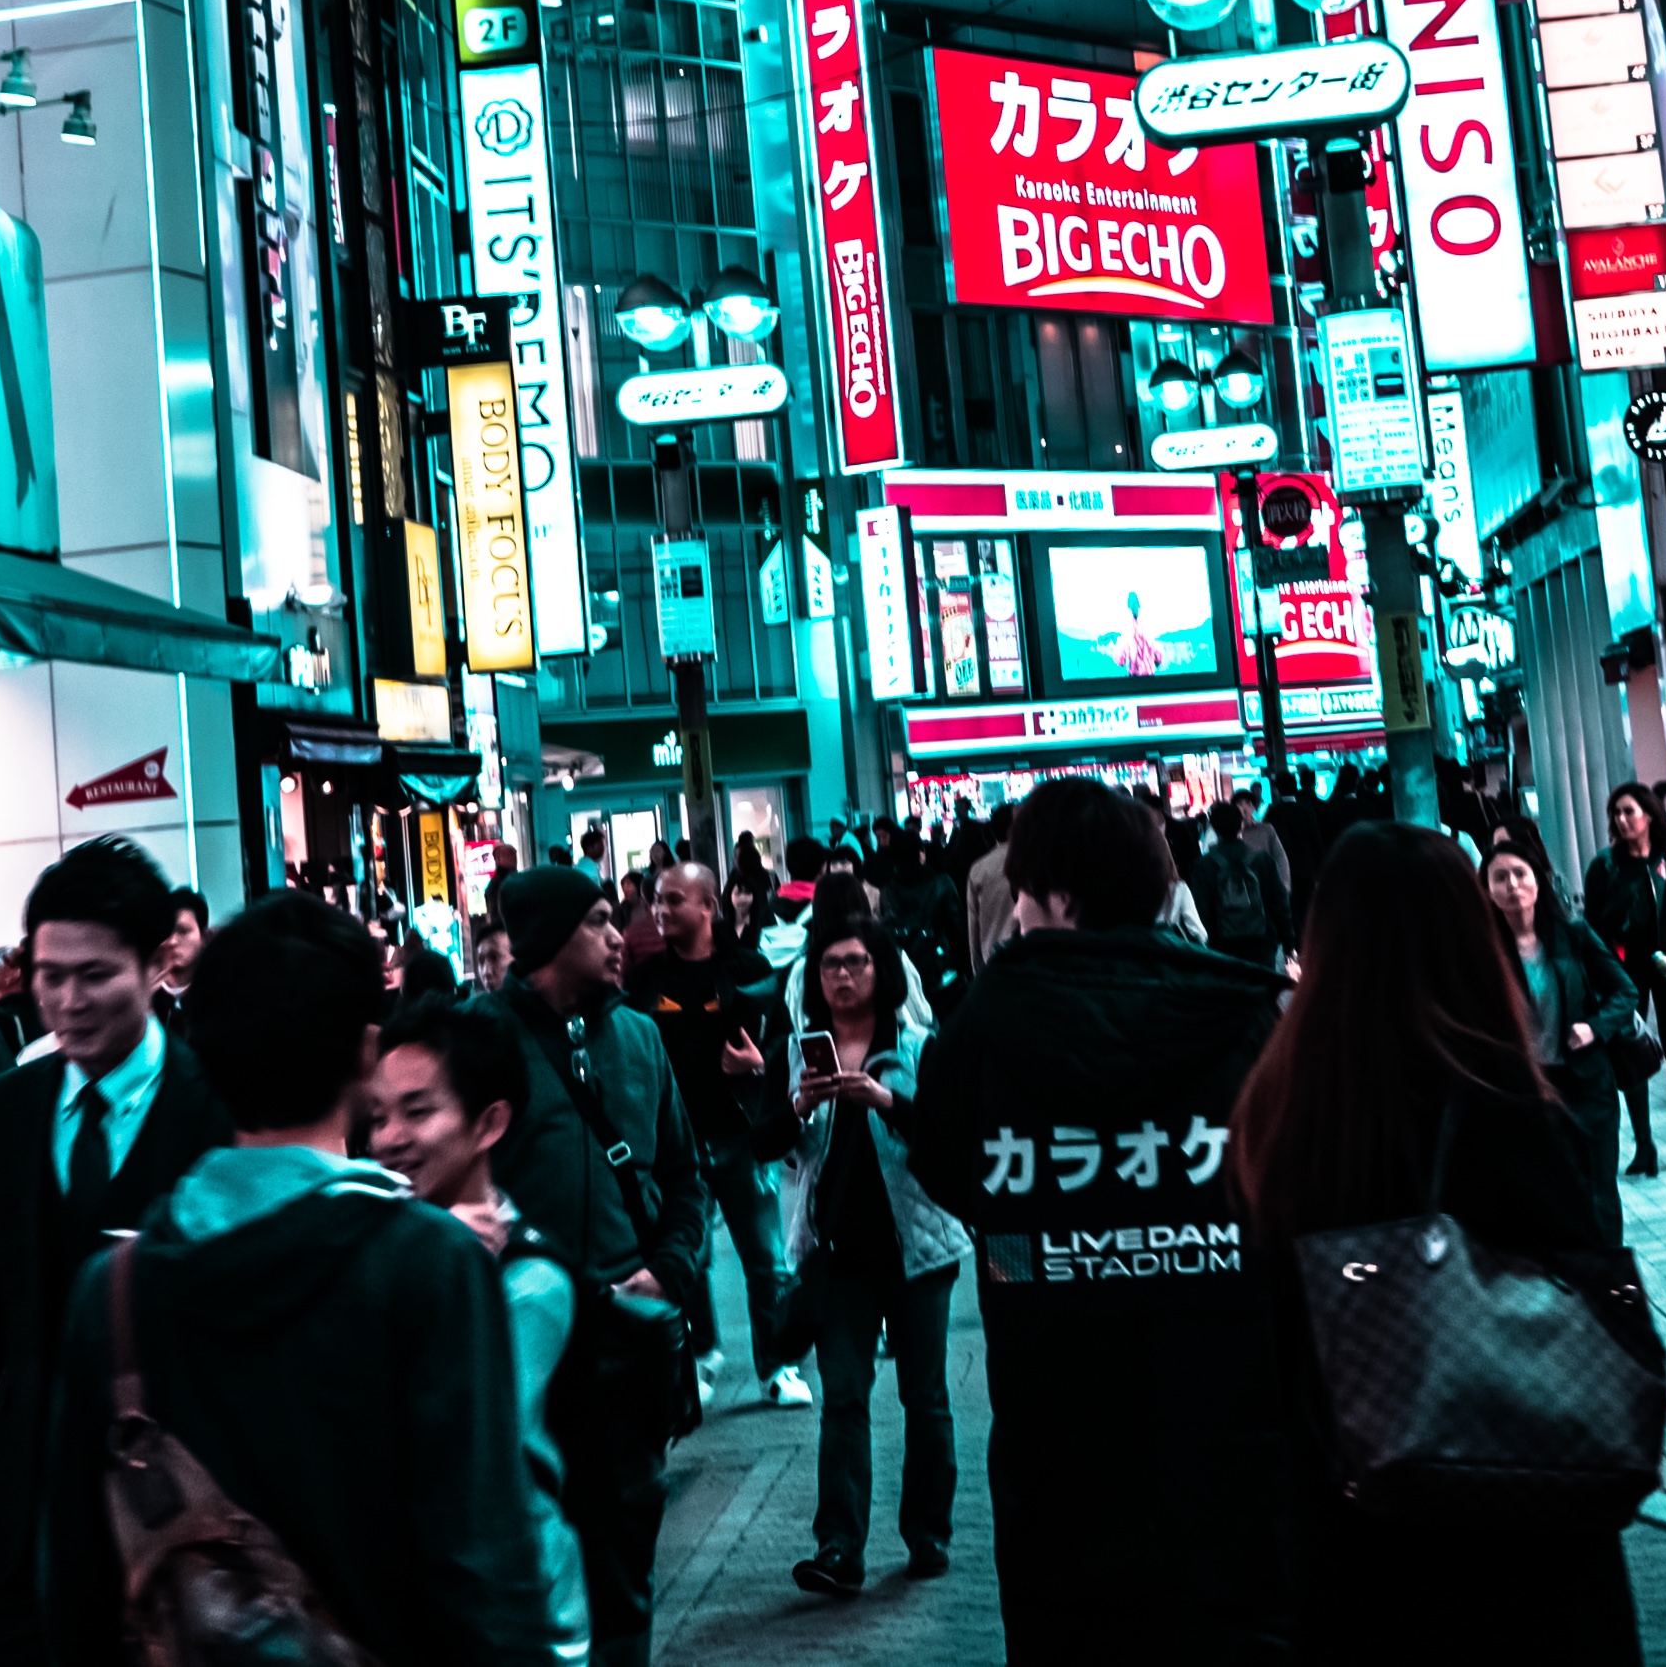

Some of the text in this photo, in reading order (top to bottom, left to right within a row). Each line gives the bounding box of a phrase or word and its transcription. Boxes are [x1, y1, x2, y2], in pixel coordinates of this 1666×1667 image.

[477, 15, 520, 46] 2F
[1149, 58, 1389, 116] 渋谷センター街
[990, 71, 1200, 176] カラオ
[1014, 173, 1198, 216] Karaoke Entertainment
[996, 203, 1226, 300] BIG ECHO
[1583, 252, 1658, 272] AVALANCHE
[441, 304, 487, 346] BF
[834, 238, 878, 419] BIG ECHO
[1433, 405, 1463, 523] Mean's
[478, 397, 524, 639] BODY FOCUS
[1265, 500, 1308, 524] 消火栓
[1059, 705, 1131, 728] ココカラファイン
[84, 779, 160, 802] RESTAURANT
[982, 1115, 1232, 1196] カラオケ
[1043, 1249, 1242, 1282] STADIUM
